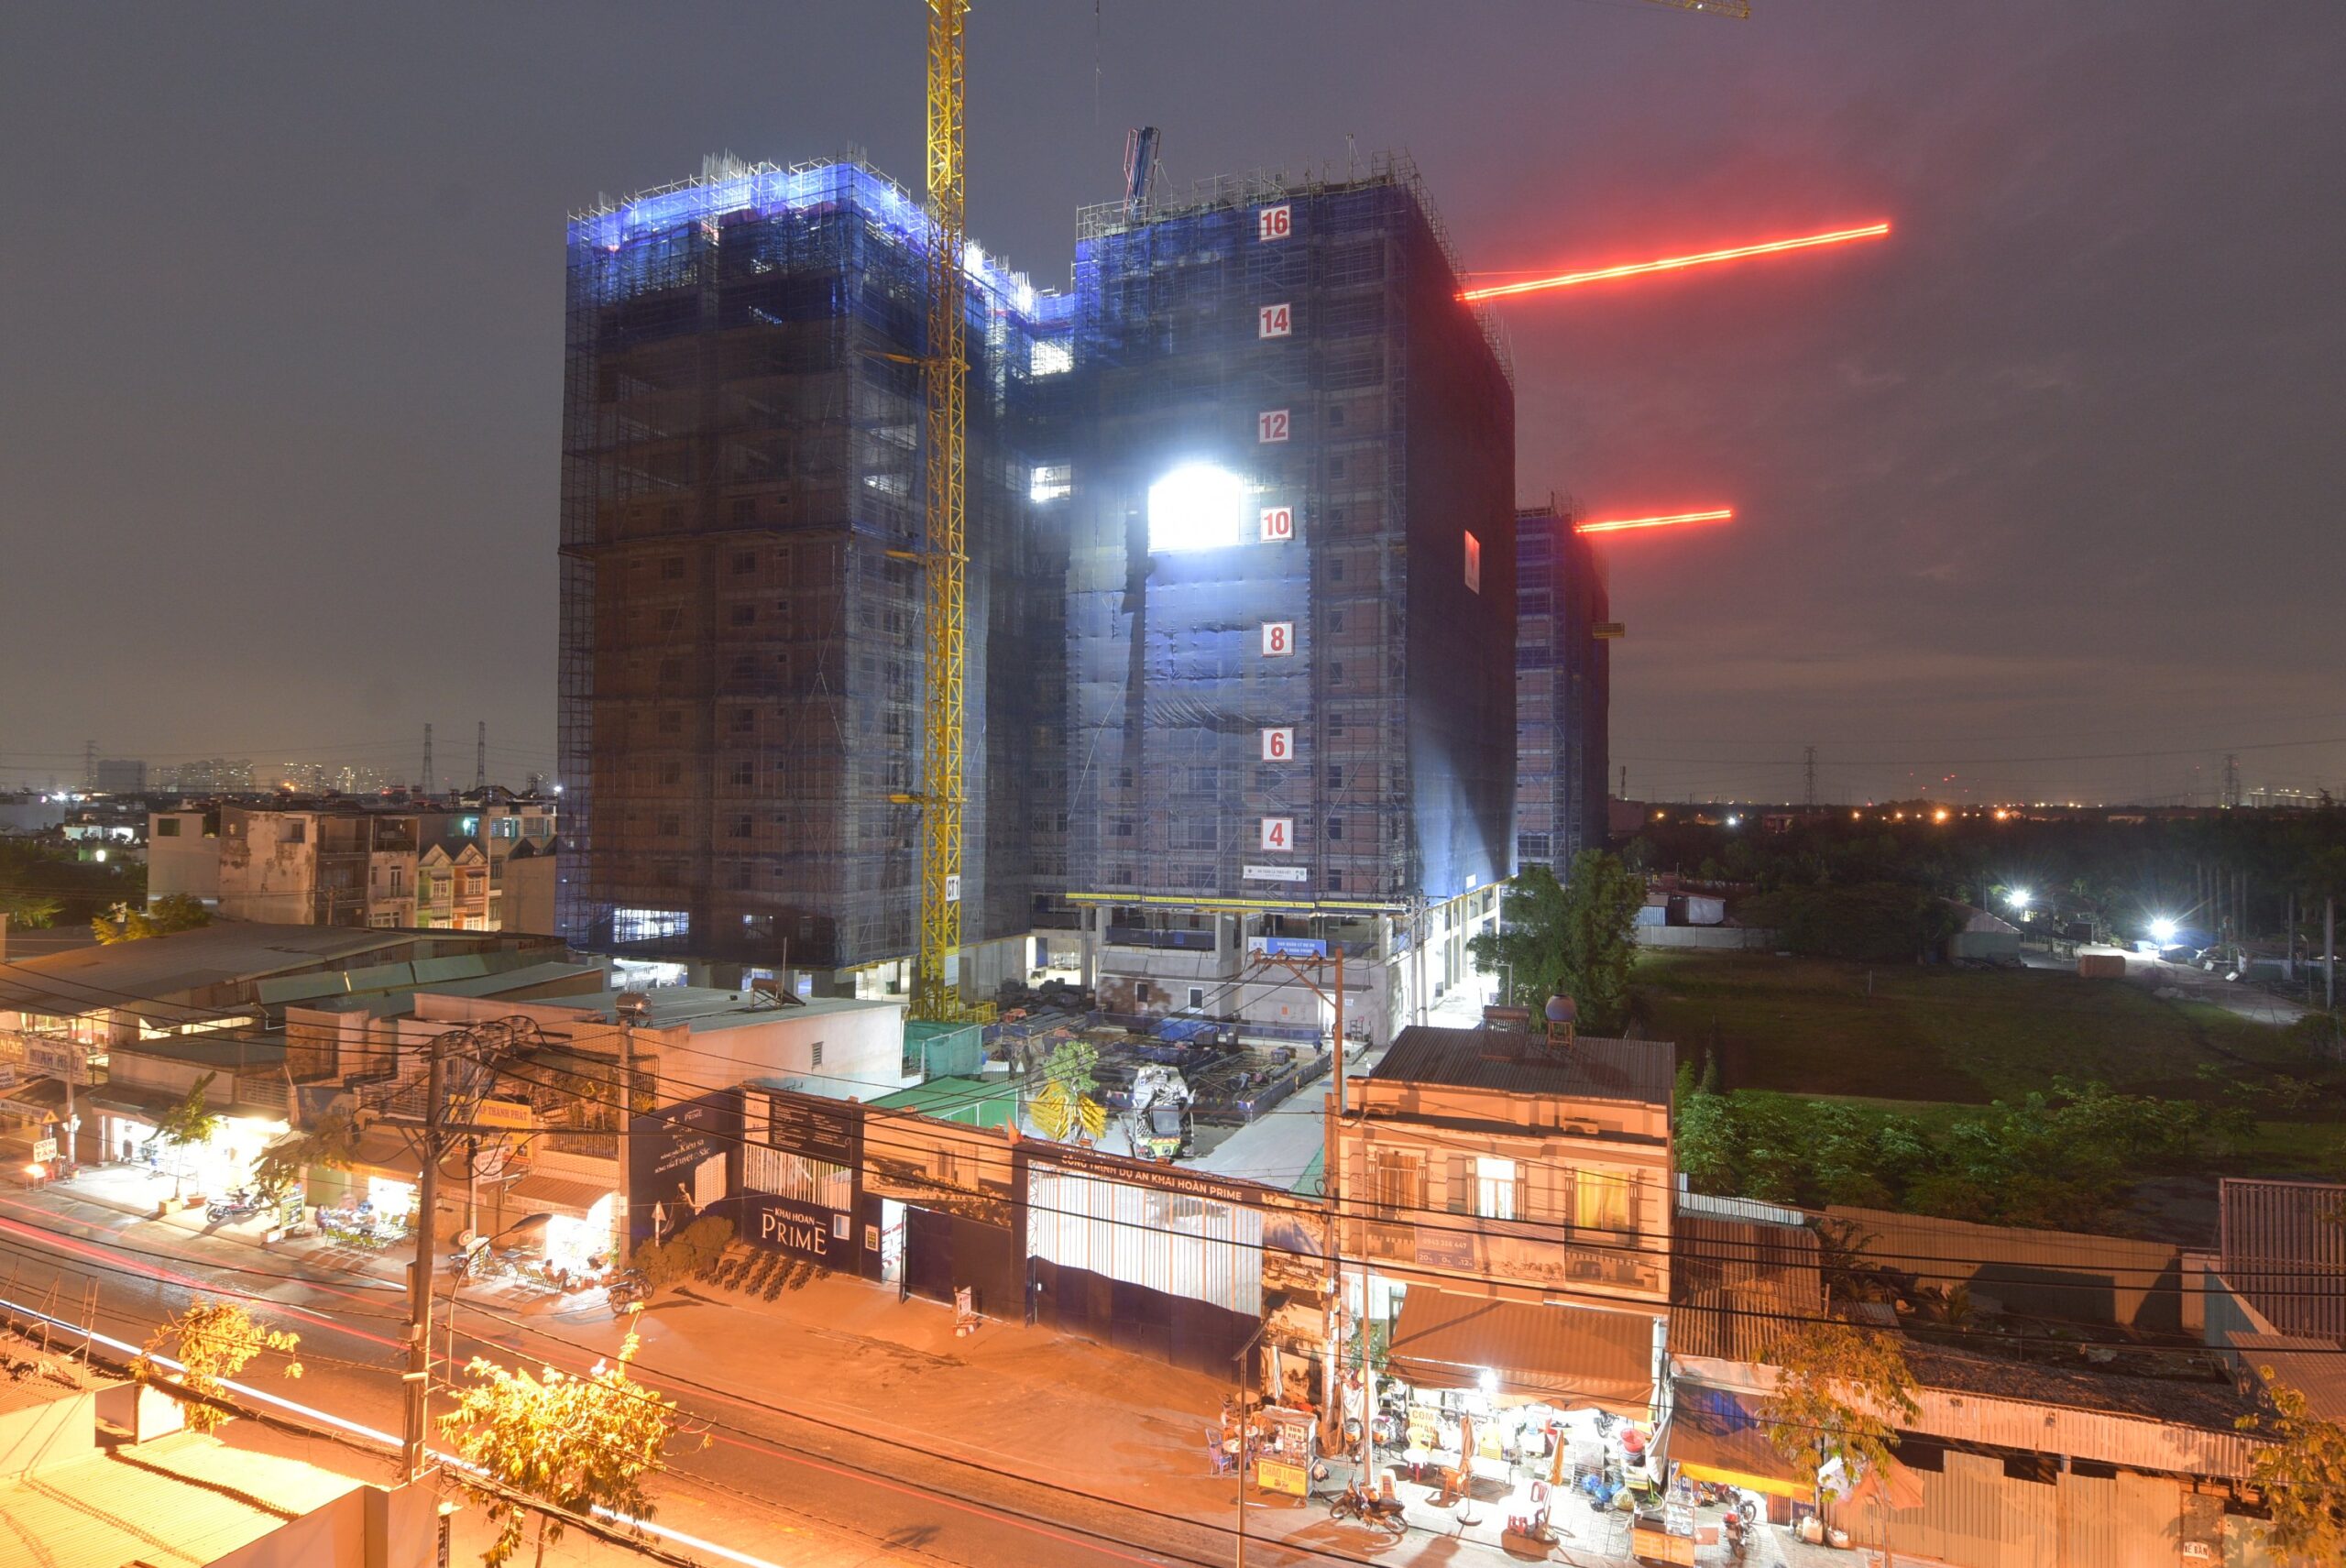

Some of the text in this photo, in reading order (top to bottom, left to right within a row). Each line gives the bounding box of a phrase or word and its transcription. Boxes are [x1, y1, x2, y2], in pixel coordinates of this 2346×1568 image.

[1262, 209, 1288, 236] 16
[1262, 307, 1288, 333] 14
[1261, 413, 1286, 439] 12
[1264, 511, 1288, 535] 10
[1270, 626, 1285, 652] 8
[1270, 731, 1285, 756] 6
[1269, 823, 1284, 847] 4
[1178, 1180, 1207, 1193] HOÀN
[1210, 1186, 1243, 1201] PRIME
[762, 1212, 828, 1255] PRIME
